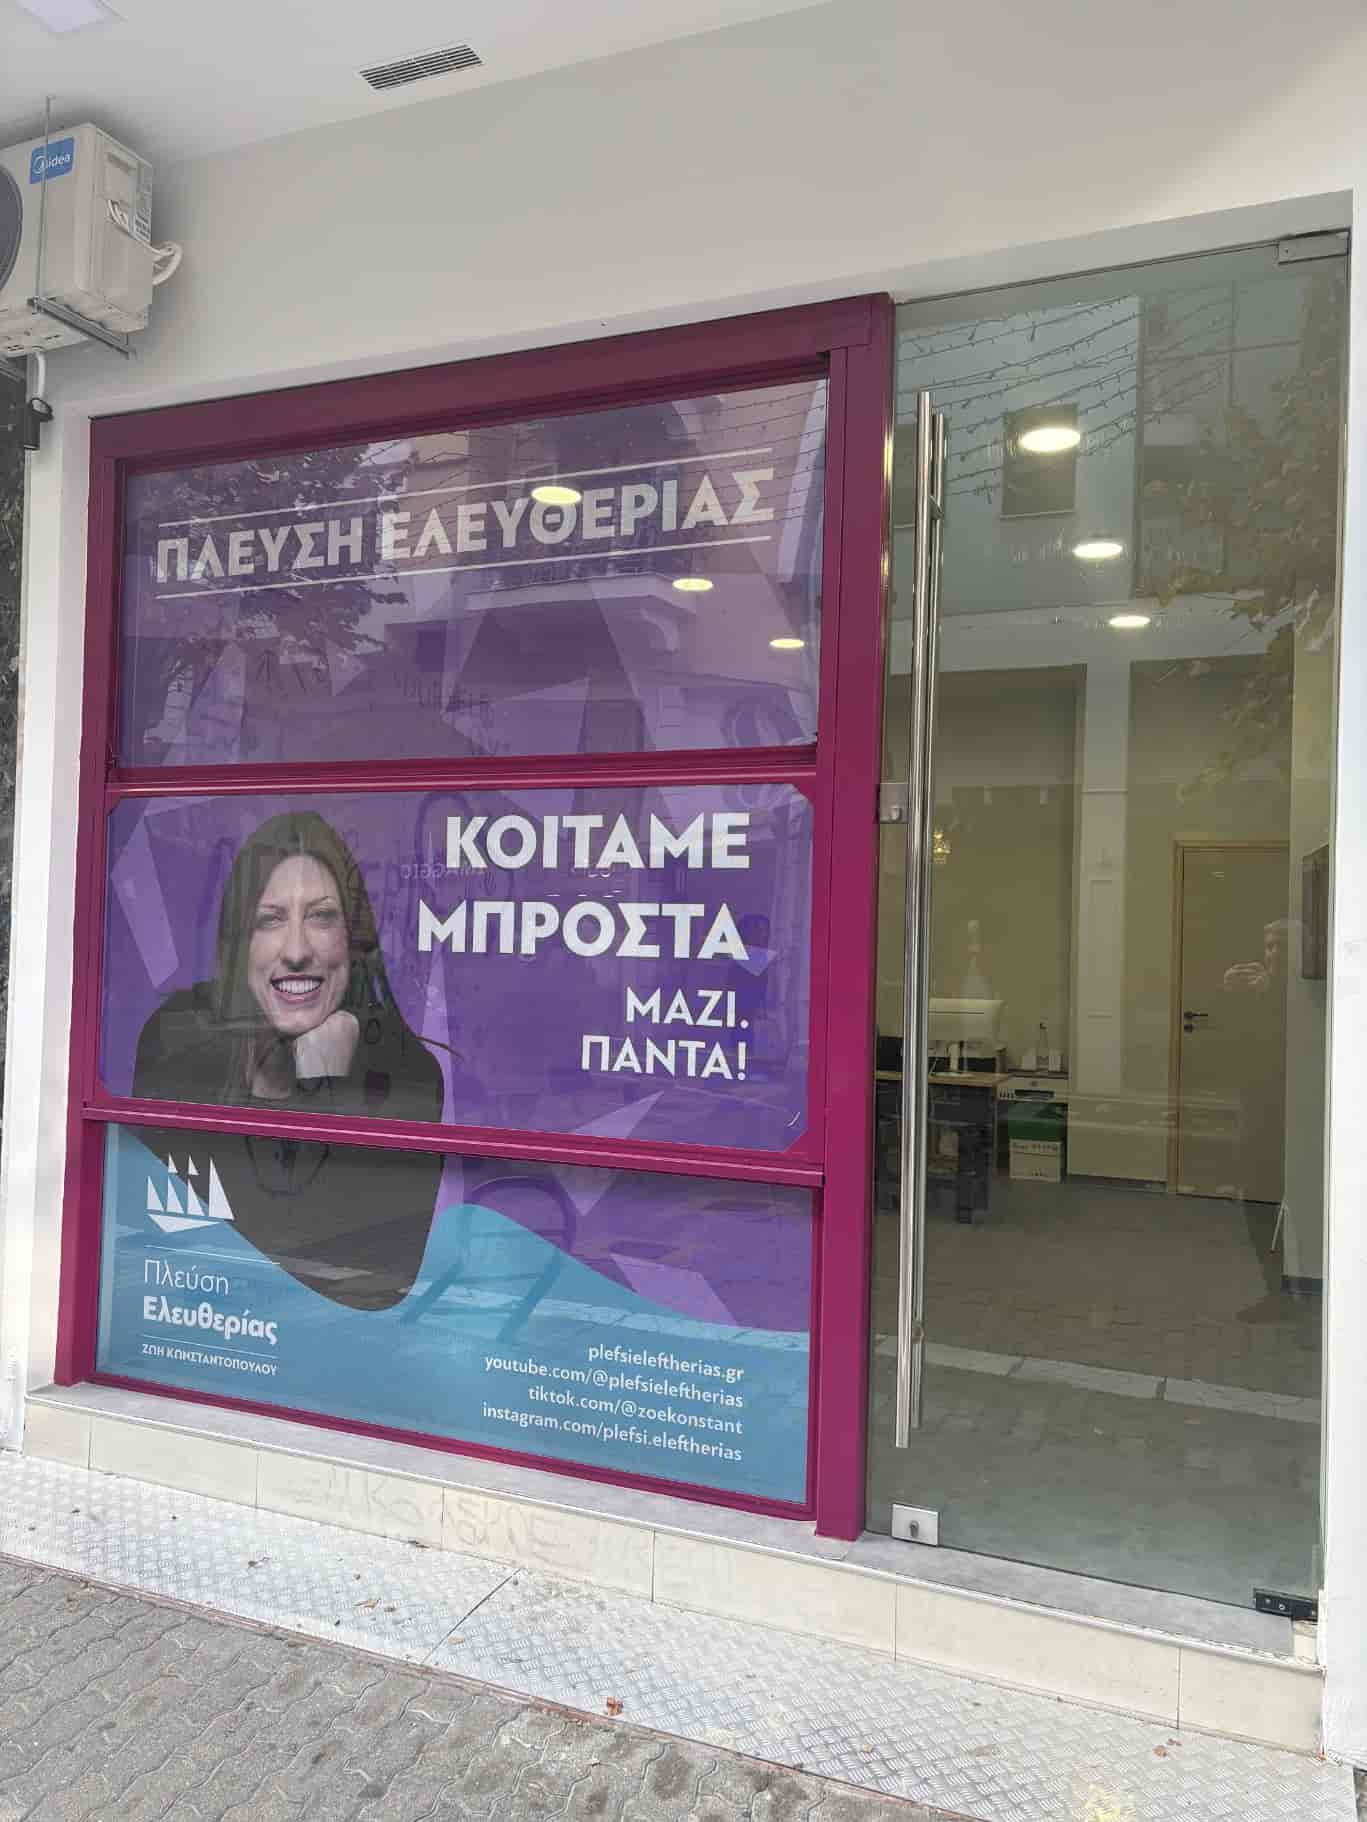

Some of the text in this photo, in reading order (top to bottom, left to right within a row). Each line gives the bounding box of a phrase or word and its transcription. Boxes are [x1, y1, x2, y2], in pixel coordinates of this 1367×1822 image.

[156, 469, 774, 584] ΠΛΕΥΣΗ ΕΛΕΥΘΕΡΙΑΣ
[445, 812, 751, 871] ΚΟΙΤΑΜΕ
[417, 899, 750, 960] ΜΠΡΟΣΤΑ
[625, 986, 749, 1030] ΜΑΖΙ.
[580, 1034, 748, 1081] ΠΑΝΤΑ!
[144, 1259, 230, 1296] Πλεύση
[143, 1295, 278, 1345] Ελευθερίας
[142, 1343, 165, 1357] ΖΩΗ
[587, 1343, 744, 1384] plefsieleftherias.gr
[484, 1355, 744, 1409] youtube.com/@plefsieleftherias
[482, 1401, 742, 1462] instagram.com/plefsi.eleftherias
[528, 1385, 743, 1435] tiktok.com/@zoekonstant
